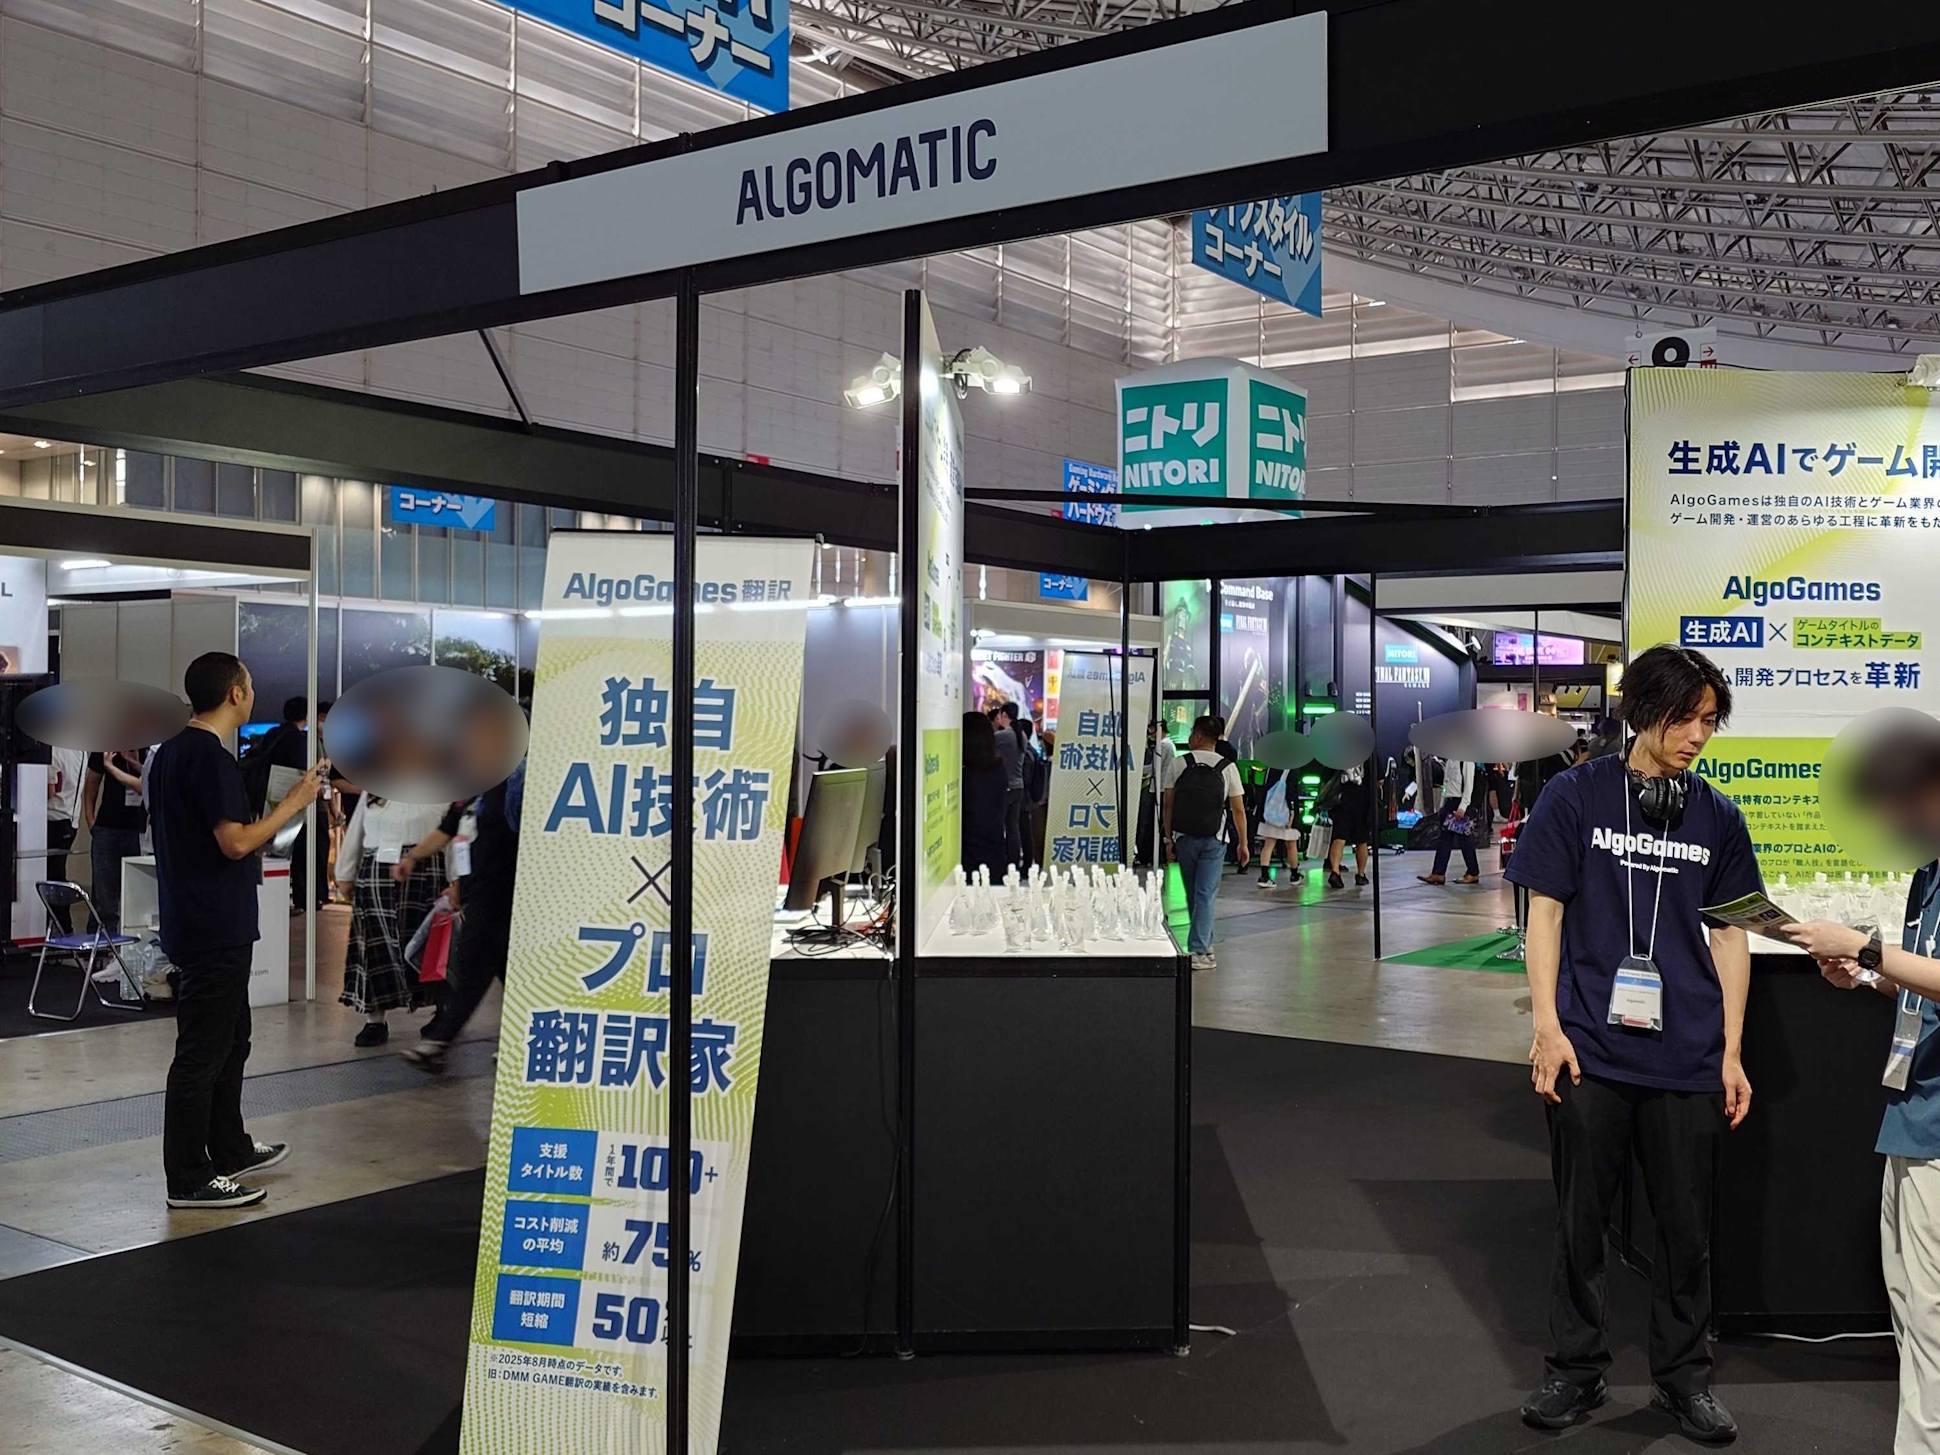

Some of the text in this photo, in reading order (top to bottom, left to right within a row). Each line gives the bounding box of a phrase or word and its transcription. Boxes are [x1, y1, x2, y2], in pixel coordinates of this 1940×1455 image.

[736, 118, 998, 225] ALGOMATIC
[1205, 222, 1282, 277] コーナー
[1125, 402, 1220, 453] ニトリ
[1125, 458, 1220, 489] NITORI
[1255, 459, 1307, 495] NITOR
[400, 493, 463, 514] コーナー
[1669, 493, 1940, 510] AlgoGamesは独自のAI技術とゲーム業界
[1043, 577, 1074, 590] コーナー
[1256, 586, 1274, 601] Base
[1722, 576, 1882, 607] AlgoGames
[1685, 620, 1758, 644] 生成AI
[1797, 633, 1920, 649] コンテキストデータ
[1387, 649, 1416, 659] NITORI
[600, 676, 736, 751] 独自
[543, 762, 770, 842] AI技術
[1591, 828, 1711, 866] AlgoGames
[577, 922, 710, 996] プロ
[526, 1010, 737, 1093] 翻訳家
[539, 1143, 568, 1160] 支援
[521, 1163, 584, 1182] タイトル数
[513, 1216, 580, 1233] コスト削減
[522, 1237, 564, 1254] の平均
[508, 1290, 566, 1309] 翻訳期間
[519, 1312, 549, 1329] 短縮
